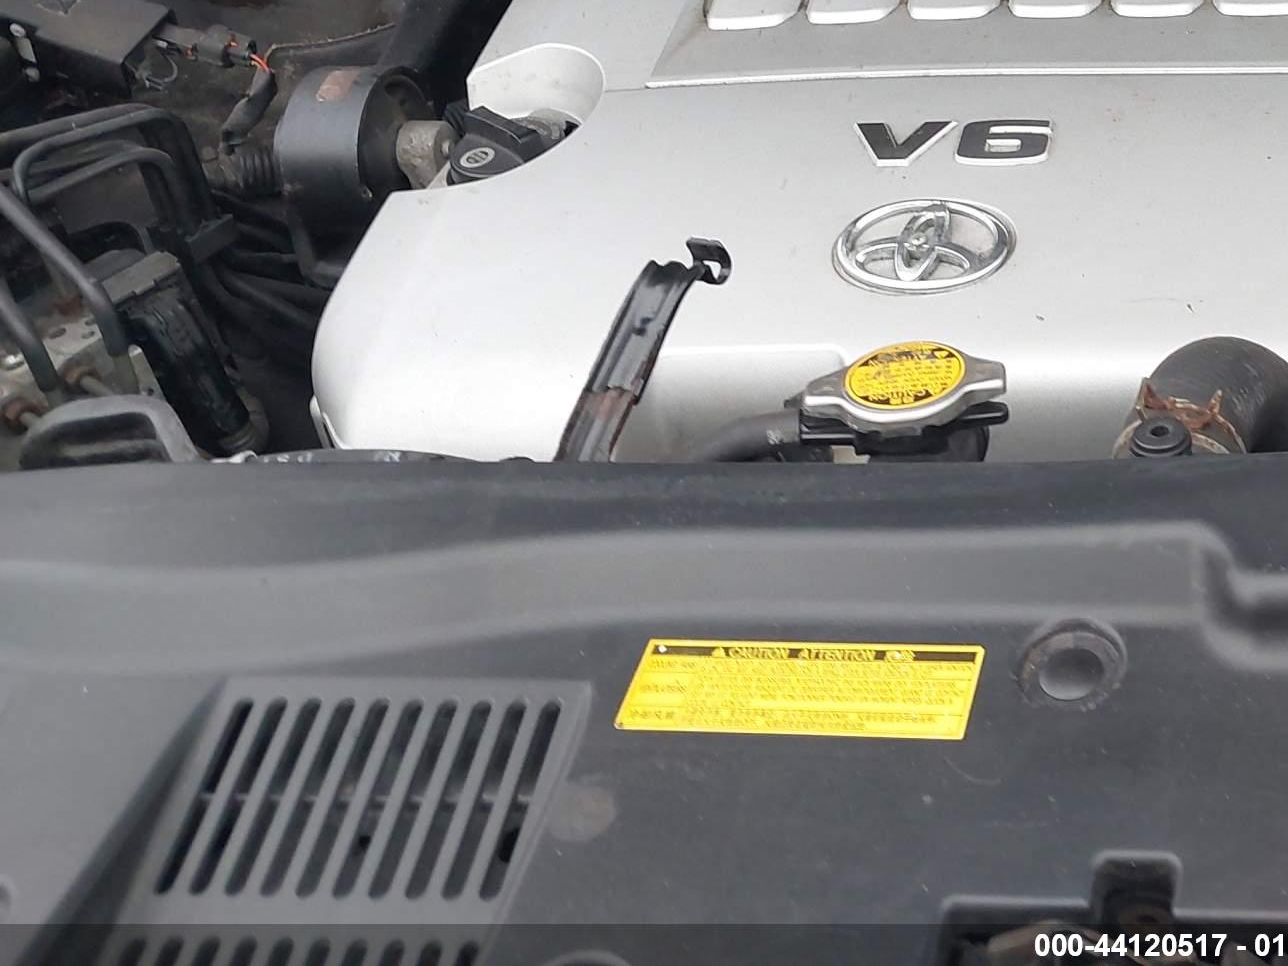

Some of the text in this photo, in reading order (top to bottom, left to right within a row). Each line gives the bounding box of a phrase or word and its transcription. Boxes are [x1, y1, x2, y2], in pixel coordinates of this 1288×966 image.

[854, 119, 1053, 166] V6
[729, 647, 790, 662] CAUTION
[798, 647, 876, 663] ATTENTION
